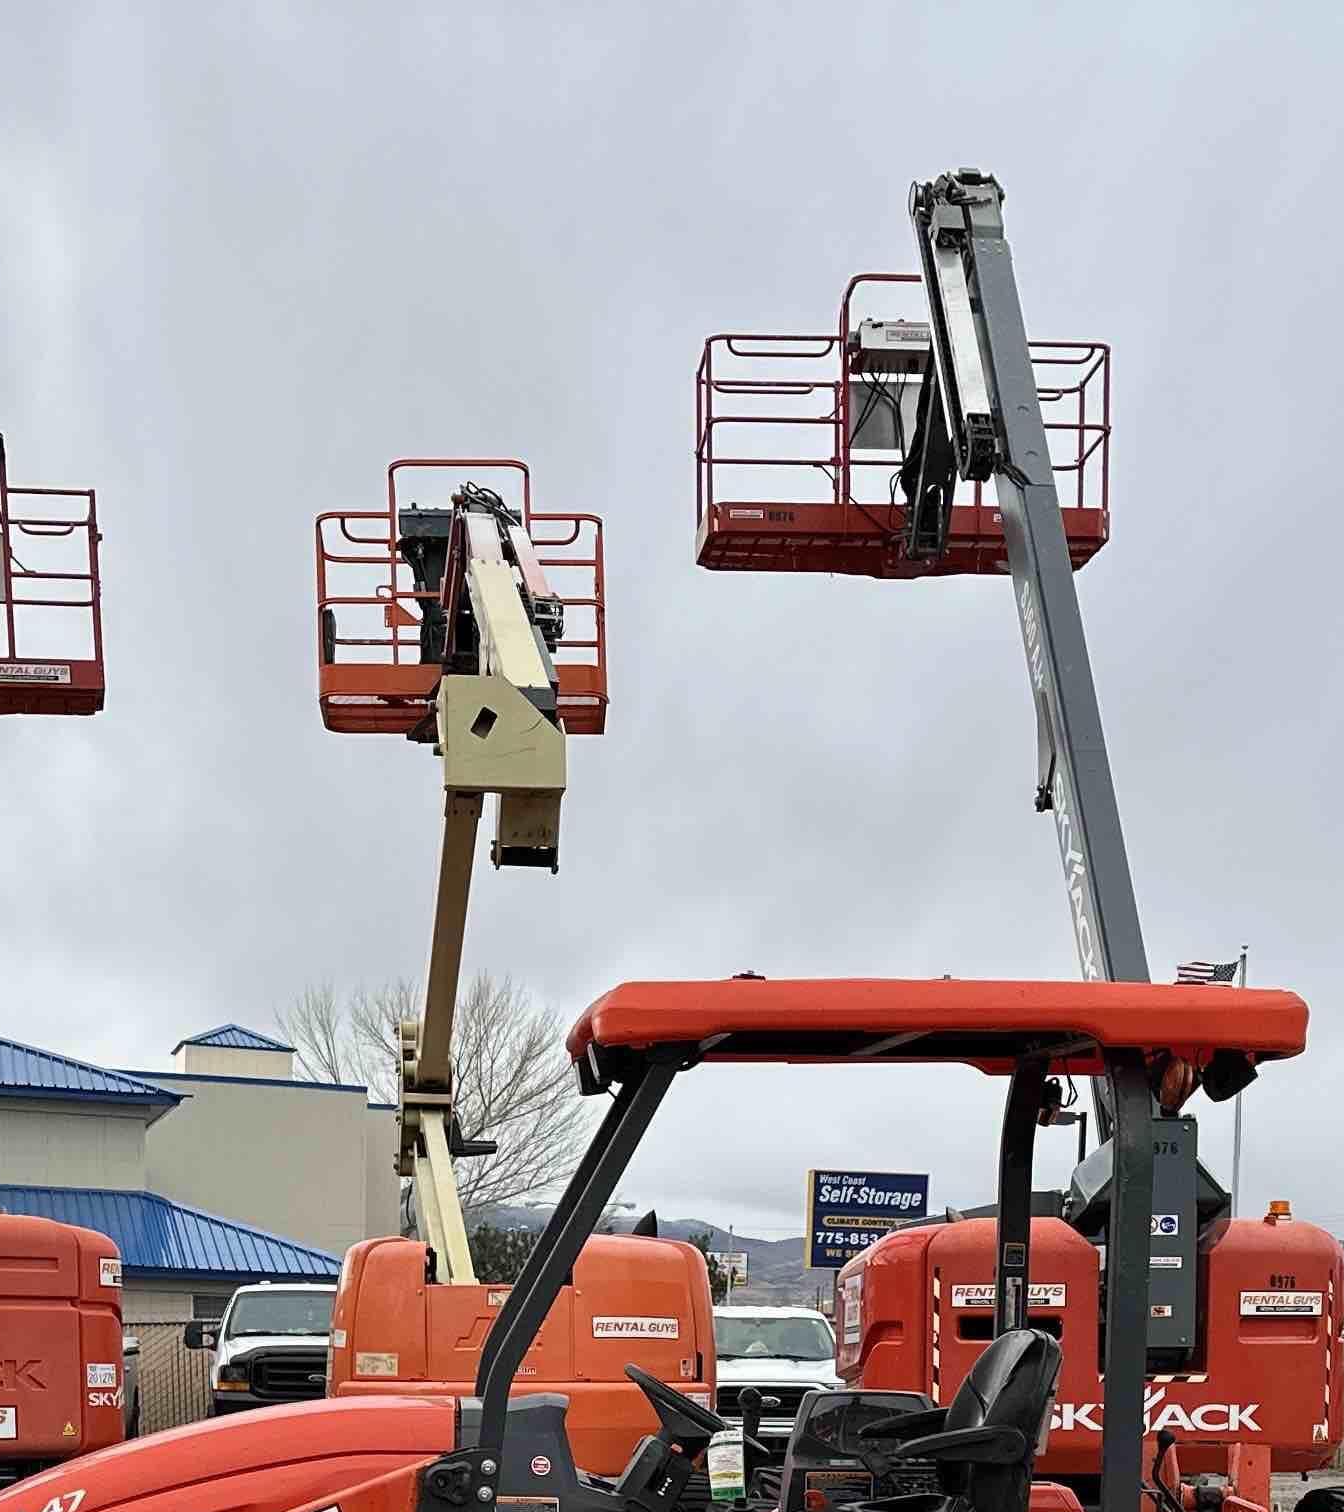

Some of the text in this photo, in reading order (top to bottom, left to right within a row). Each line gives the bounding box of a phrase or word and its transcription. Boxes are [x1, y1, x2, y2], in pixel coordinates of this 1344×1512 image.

[33, 666, 69, 675] GUYS
[819, 1174, 867, 1186] West Coast
[819, 1185, 922, 1210] Self-Storage
[954, 1286, 1065, 1297] RENT UYS
[1242, 1295, 1321, 1305] RENTAL GUYS
[594, 1321, 678, 1334] RENTAL GUYS
